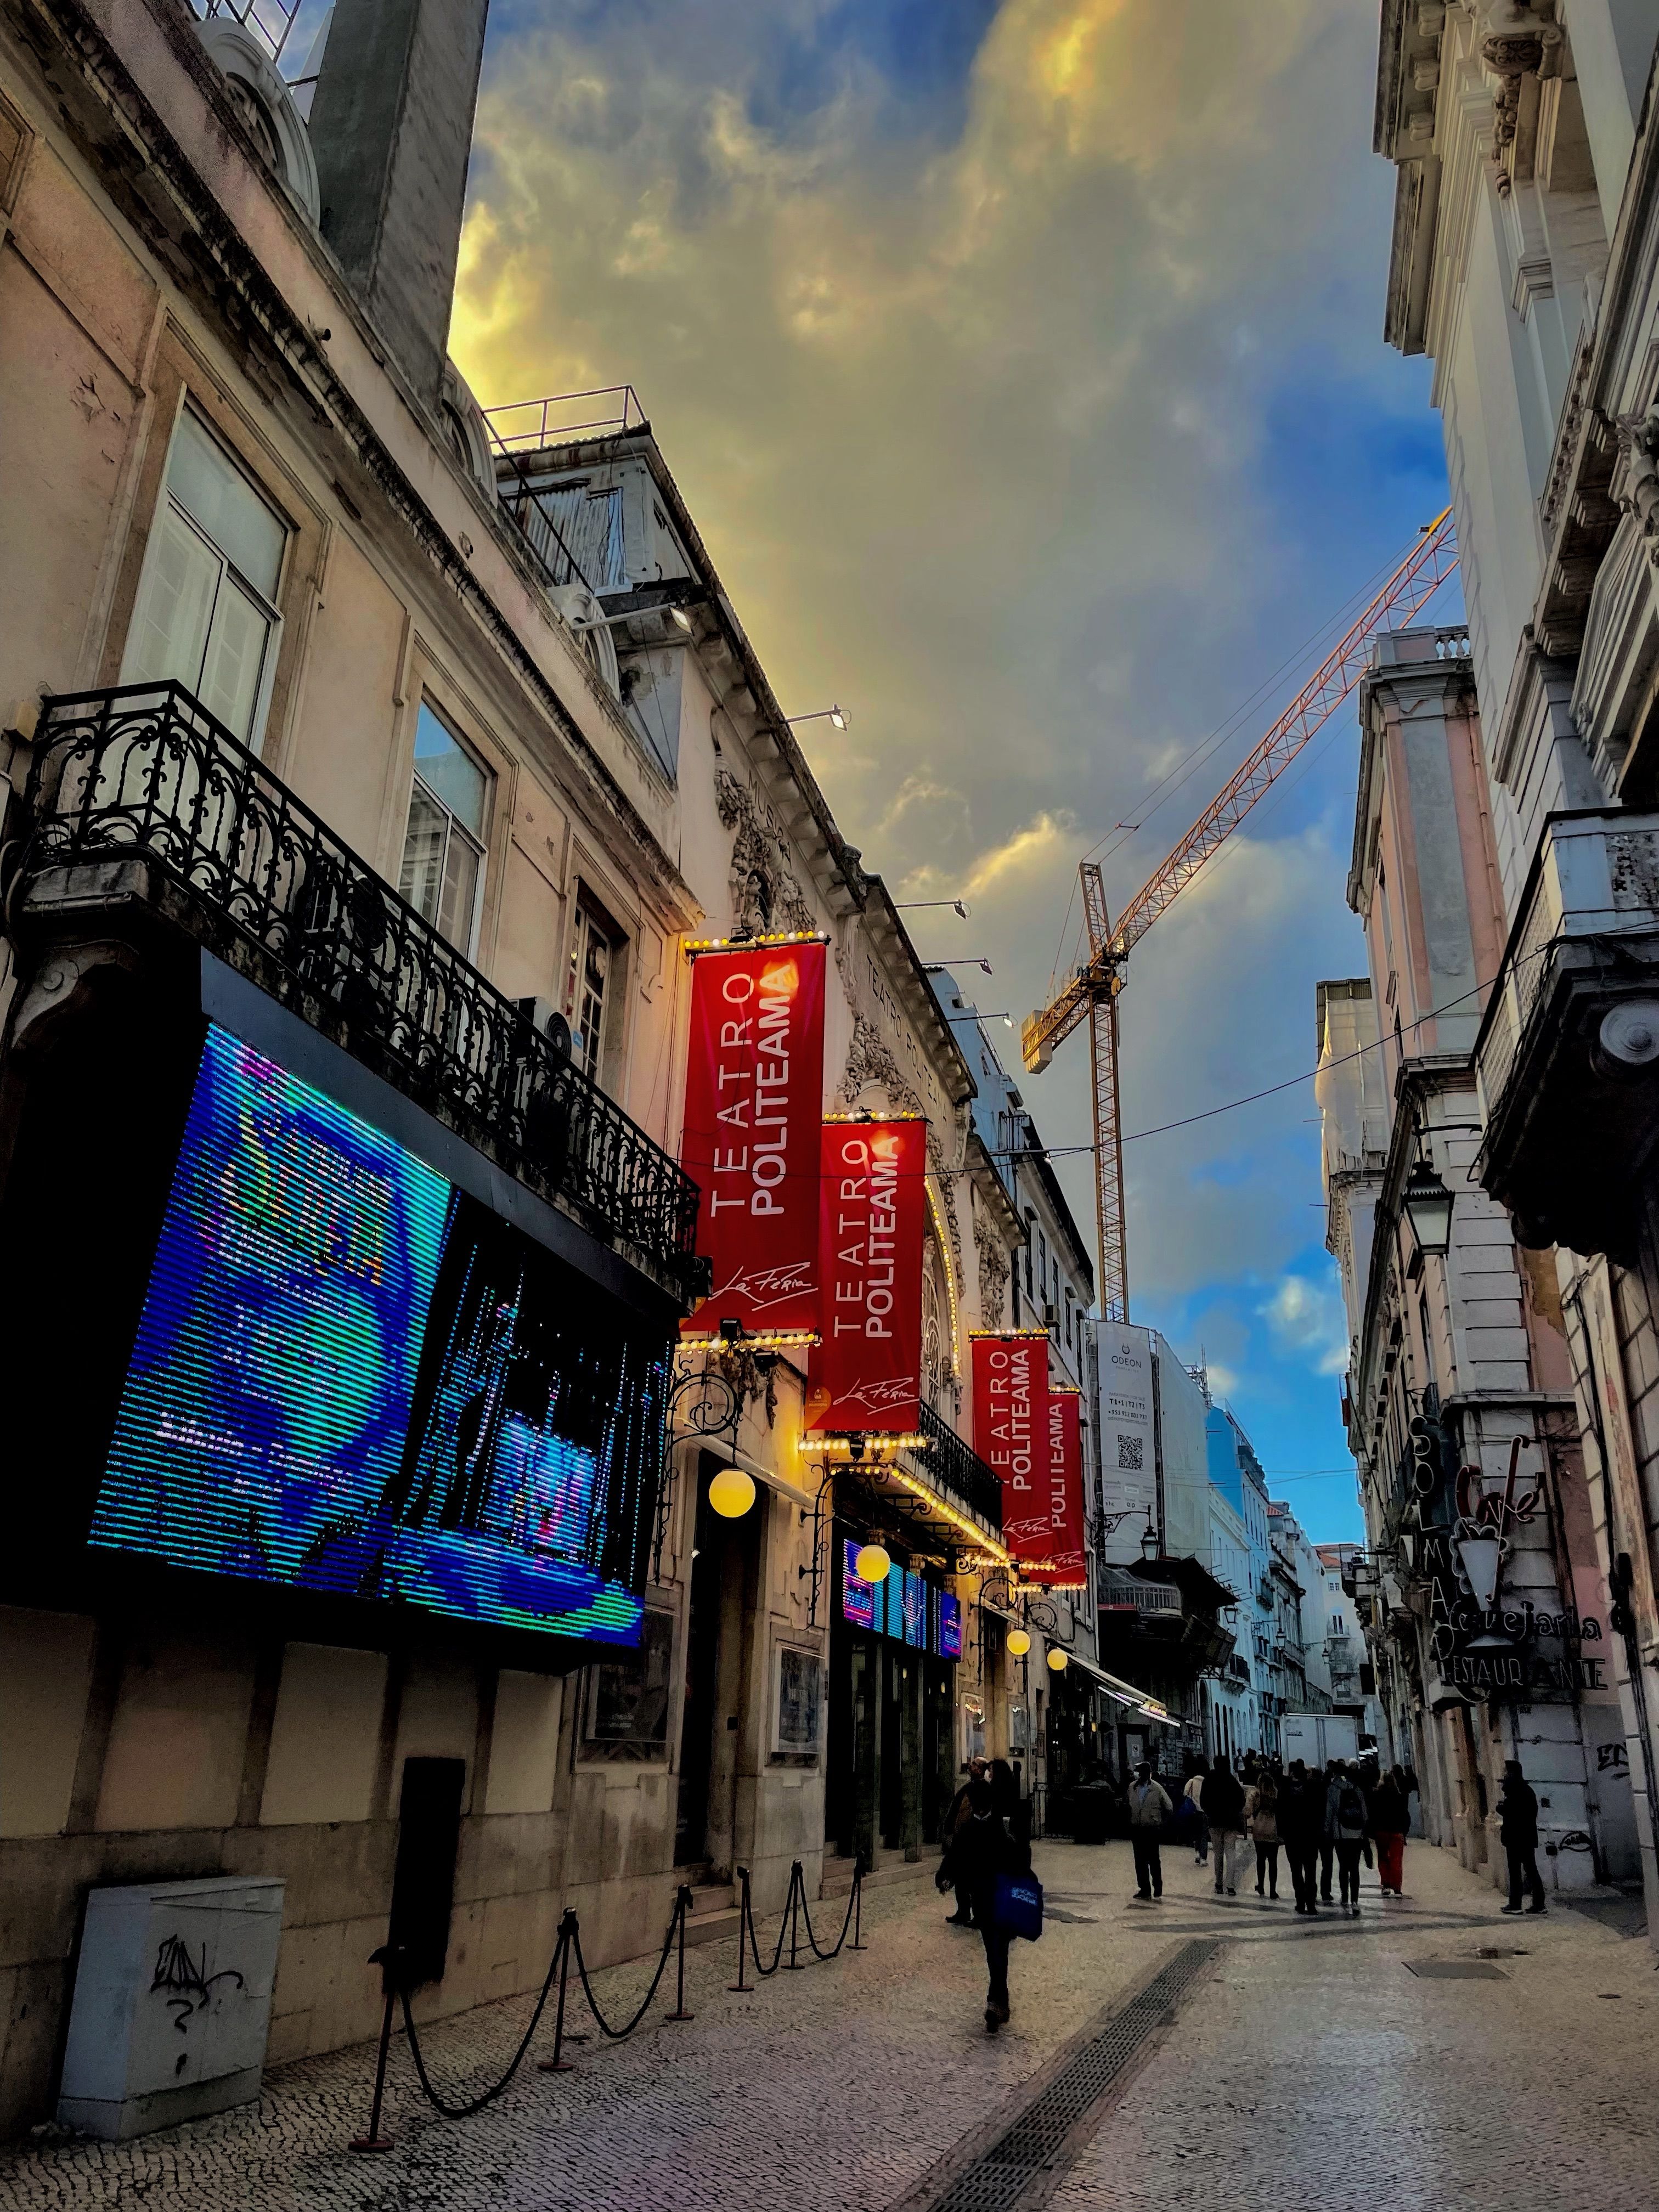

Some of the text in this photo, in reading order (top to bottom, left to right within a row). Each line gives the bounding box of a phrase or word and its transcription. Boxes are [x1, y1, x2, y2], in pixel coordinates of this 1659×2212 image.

[867, 953, 902, 1039] TEATRO
[710, 973, 754, 1217] TEATRO
[751, 964, 791, 1216] POLITEAMA
[834, 1140, 868, 1338] TEATRO
[865, 1136, 899, 1338] POLITEAMA
[989, 1351, 1010, 1484] EATRO
[1011, 1349, 1032, 1490] POLITEAMA
[1111, 1356, 1141, 1368] ODEON
